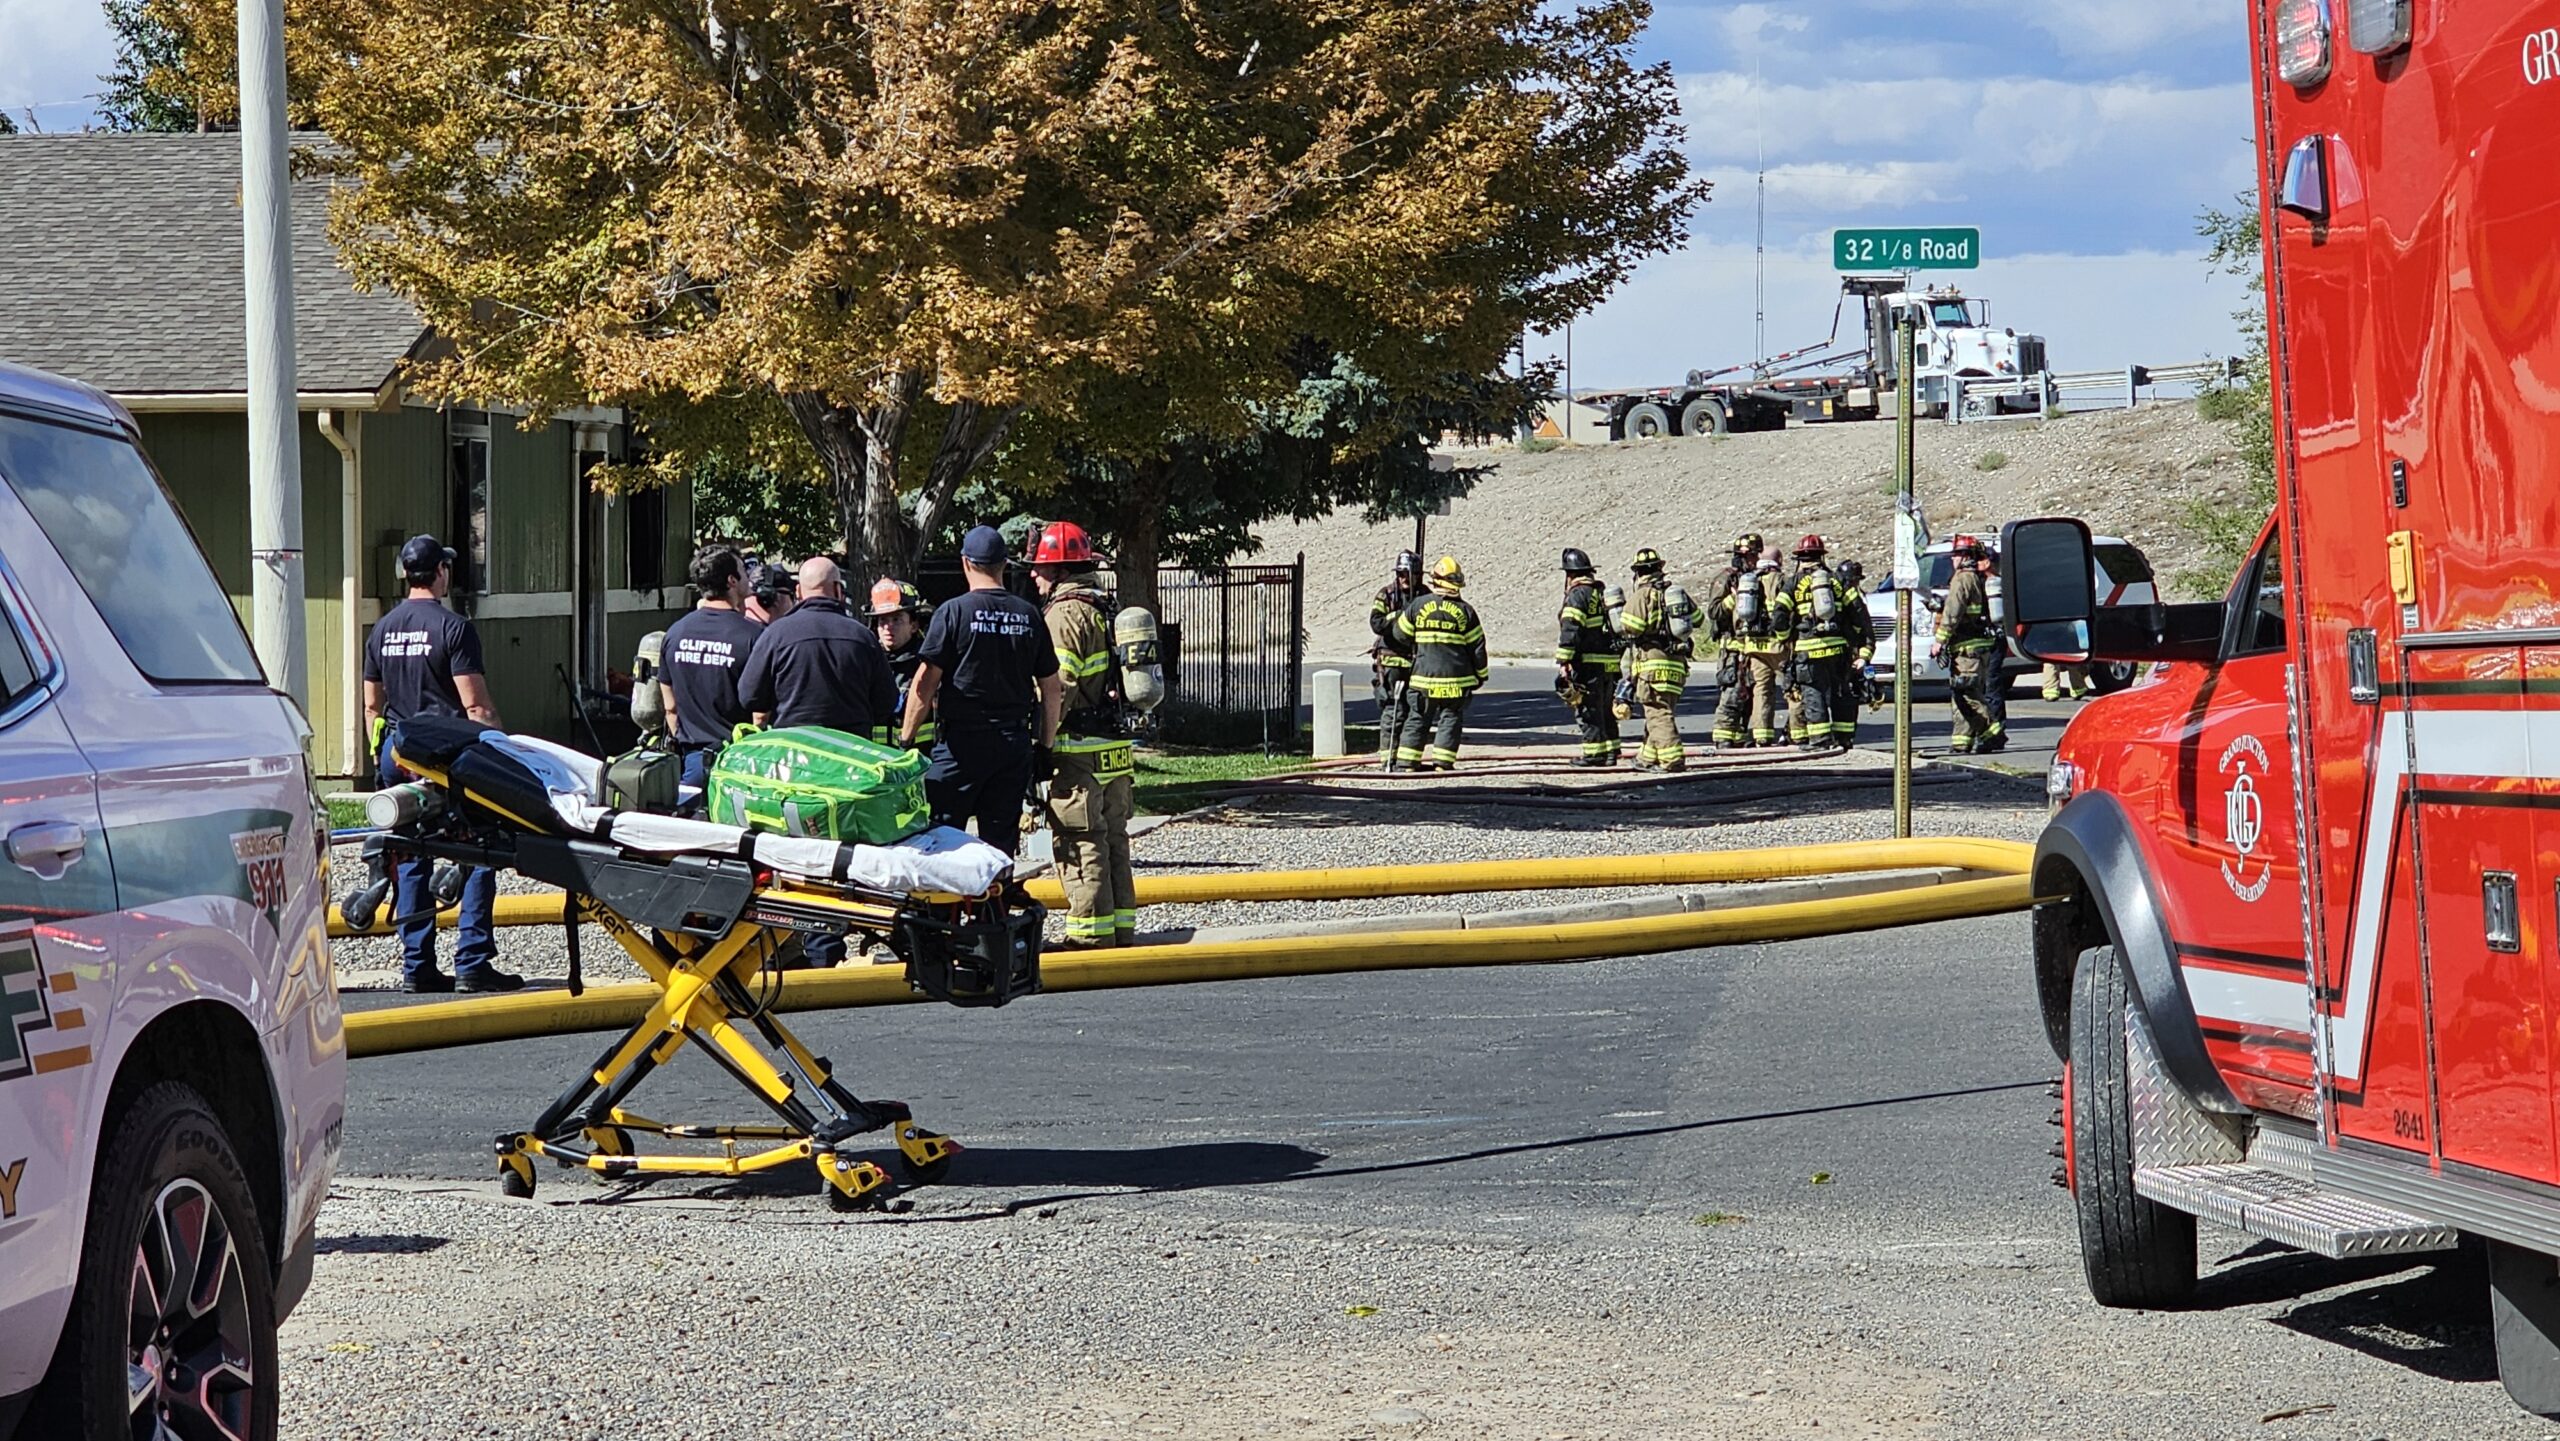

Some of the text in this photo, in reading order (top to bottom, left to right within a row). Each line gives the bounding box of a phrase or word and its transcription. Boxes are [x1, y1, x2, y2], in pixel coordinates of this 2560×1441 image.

[1845, 237, 1968, 261] 32 1/8 Road
[679, 639, 732, 655] CLIFTON
[1128, 645, 1158, 664] E-4
[674, 651, 735, 668] FIRE DEPT
[248, 859, 287, 910] 911
[579, 893, 625, 935] ryker
[2393, 1109, 2425, 1141] 2641
